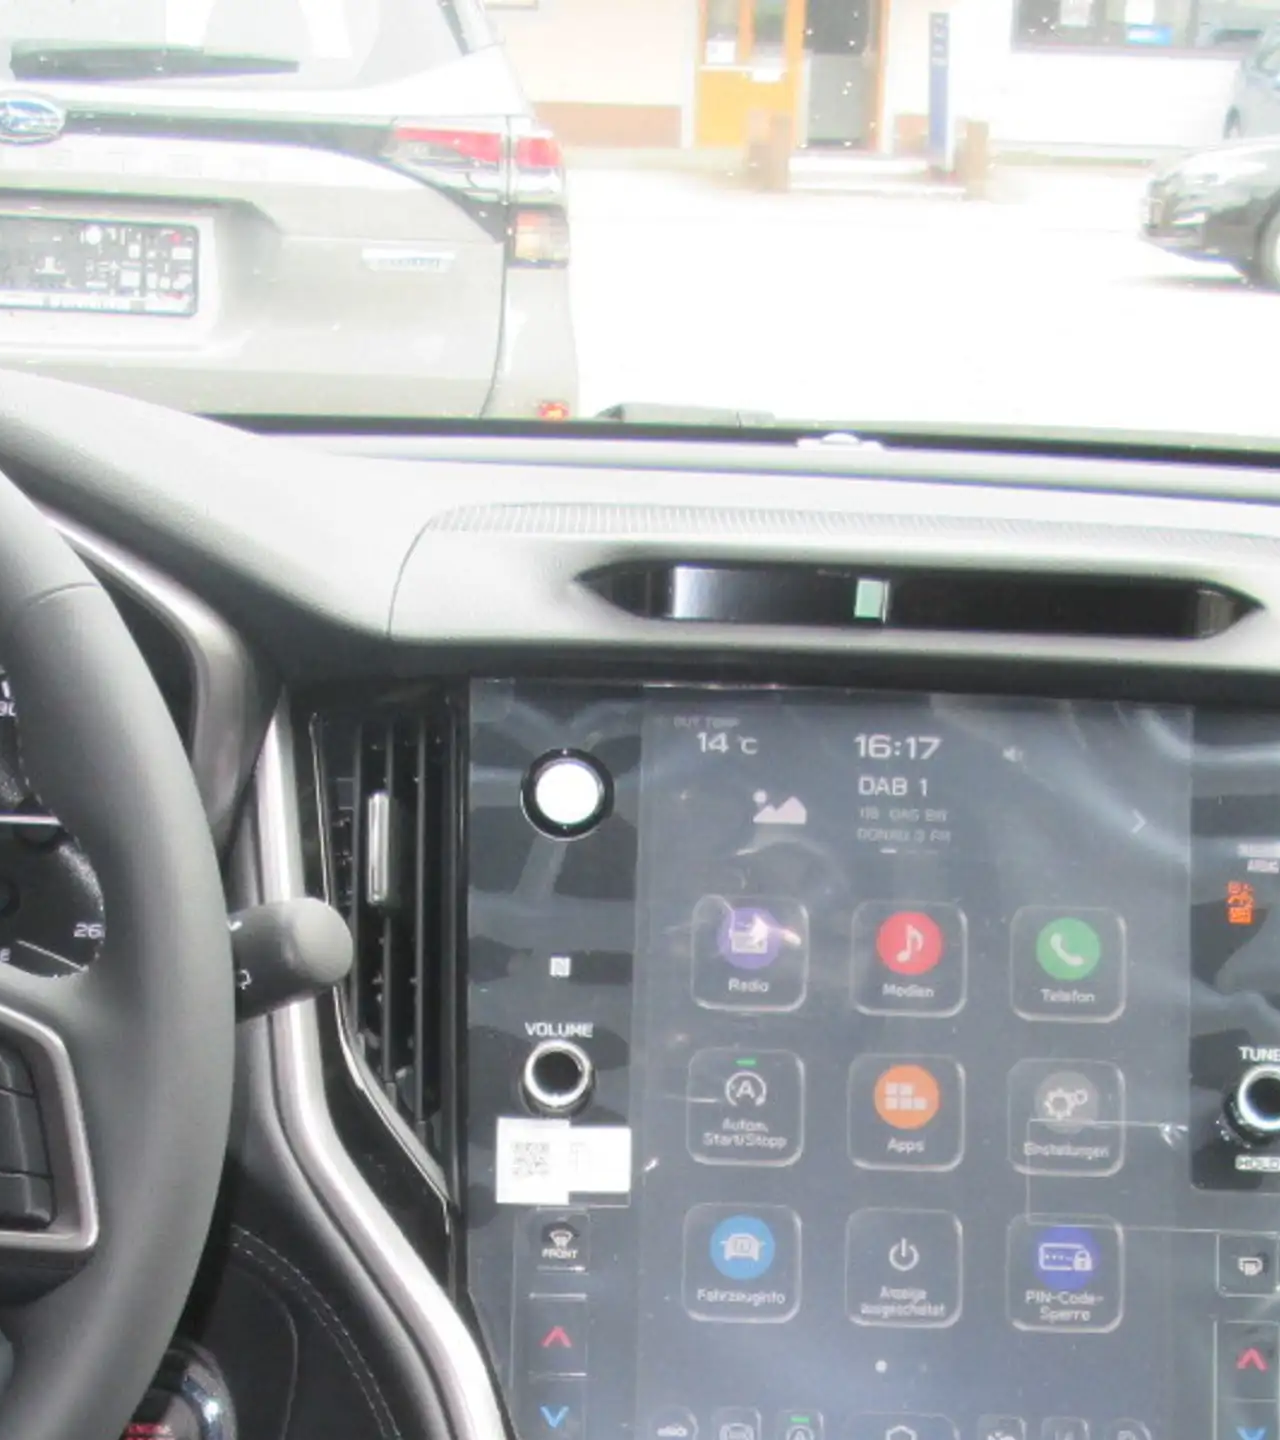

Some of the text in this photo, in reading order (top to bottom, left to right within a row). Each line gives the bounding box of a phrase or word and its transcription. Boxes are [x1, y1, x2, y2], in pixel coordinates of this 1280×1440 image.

[696, 731, 729, 754] 14
[854, 733, 942, 760] 16:17
[858, 776, 929, 797] DAB 1
[1040, 988, 1096, 1004] Telefon
[524, 1021, 594, 1038] VOLUME
